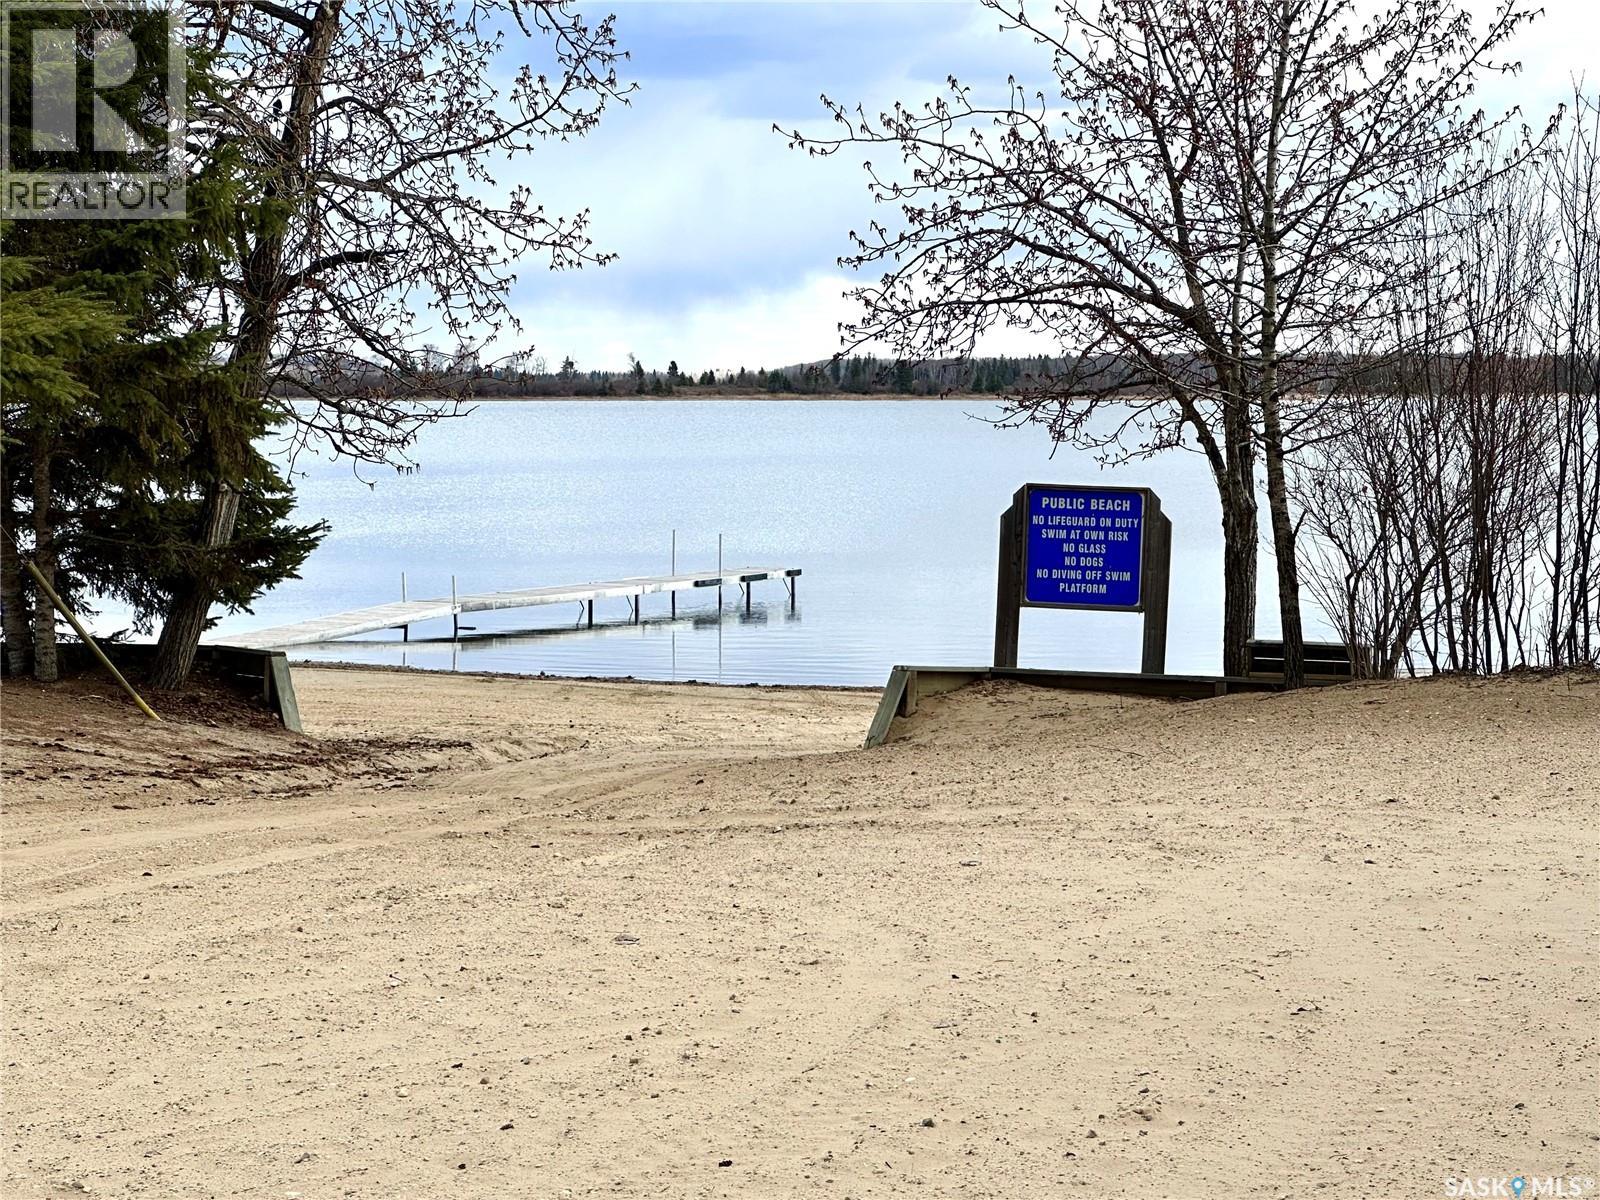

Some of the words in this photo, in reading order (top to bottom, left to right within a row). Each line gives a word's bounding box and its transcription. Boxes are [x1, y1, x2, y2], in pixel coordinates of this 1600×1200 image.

[1042, 497, 1085, 510] PUBLIC
[1090, 499, 1131, 511] BEACH
[1032, 515, 1044, 525] NO
[1048, 516, 1096, 527] LIFEGUARD
[1099, 518, 1111, 527] ON
[1115, 518, 1139, 528] DUTY
[1041, 529, 1067, 539] SWIM
[1070, 530, 1081, 539] AT
[1084, 530, 1104, 540] OWN
[1108, 531, 1129, 541] RISK
[1063, 543, 1075, 553] NO
[1078, 543, 1106, 554] GLASS
[1064, 556, 1076, 566] NO
[1080, 557, 1104, 567] DOGS
[1036, 569, 1048, 579] NO
[1052, 569, 1082, 580] DIVING
[1085, 570, 1102, 580] OFF
[1105, 571, 1131, 581] SWIM
[1059, 583, 1107, 594] PLATFORM
